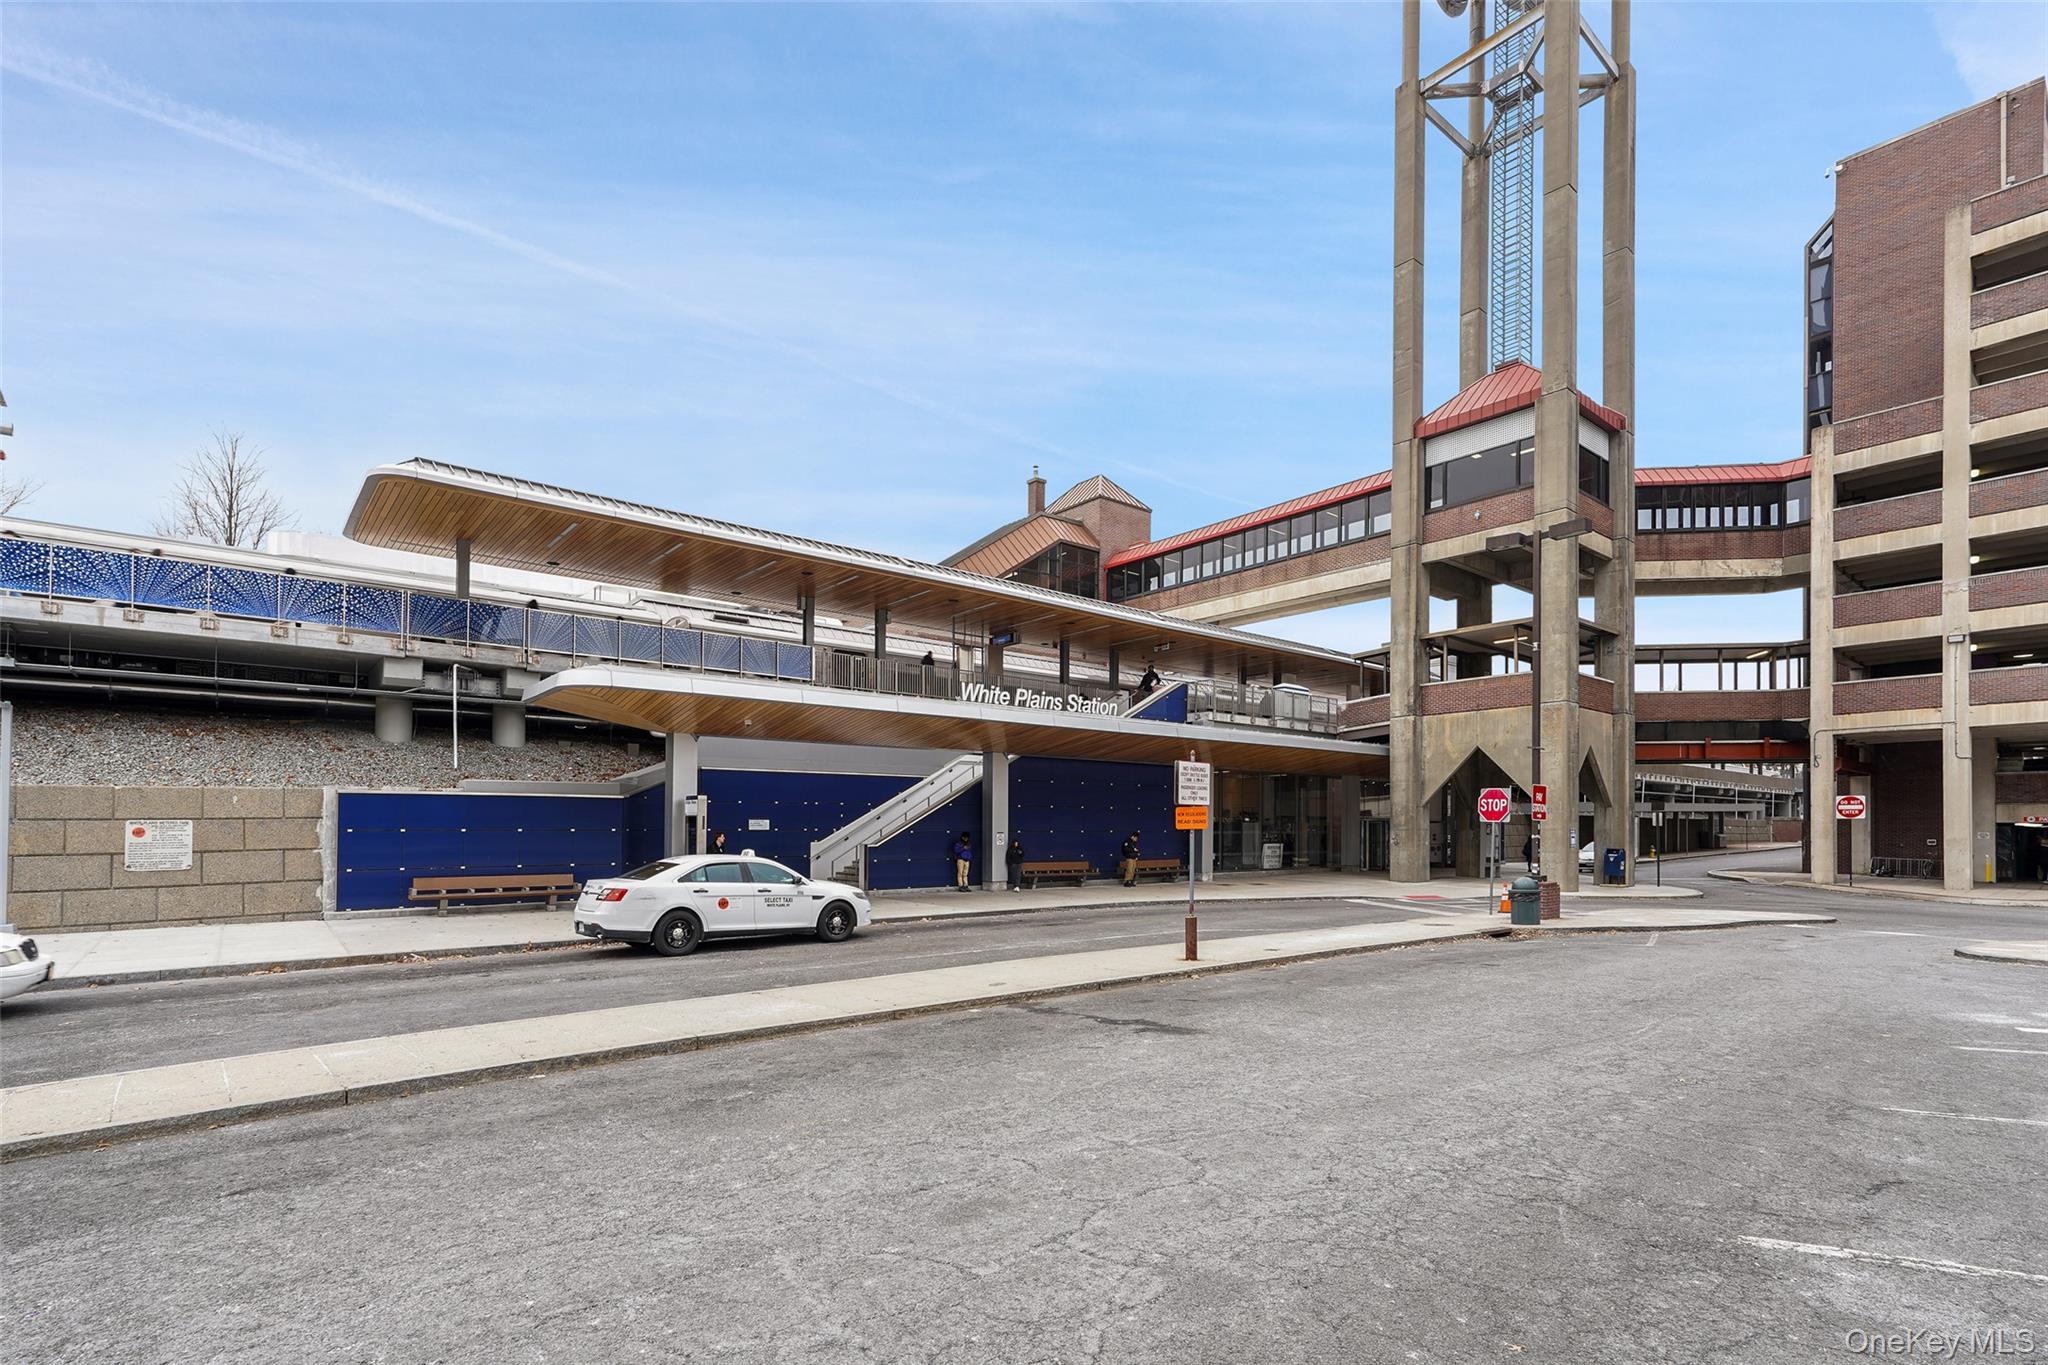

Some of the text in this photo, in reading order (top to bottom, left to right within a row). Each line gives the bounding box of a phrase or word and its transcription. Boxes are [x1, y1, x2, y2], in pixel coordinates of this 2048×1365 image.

[961, 682, 1118, 716] White Plains Station
[1480, 798, 1507, 811] STOP
